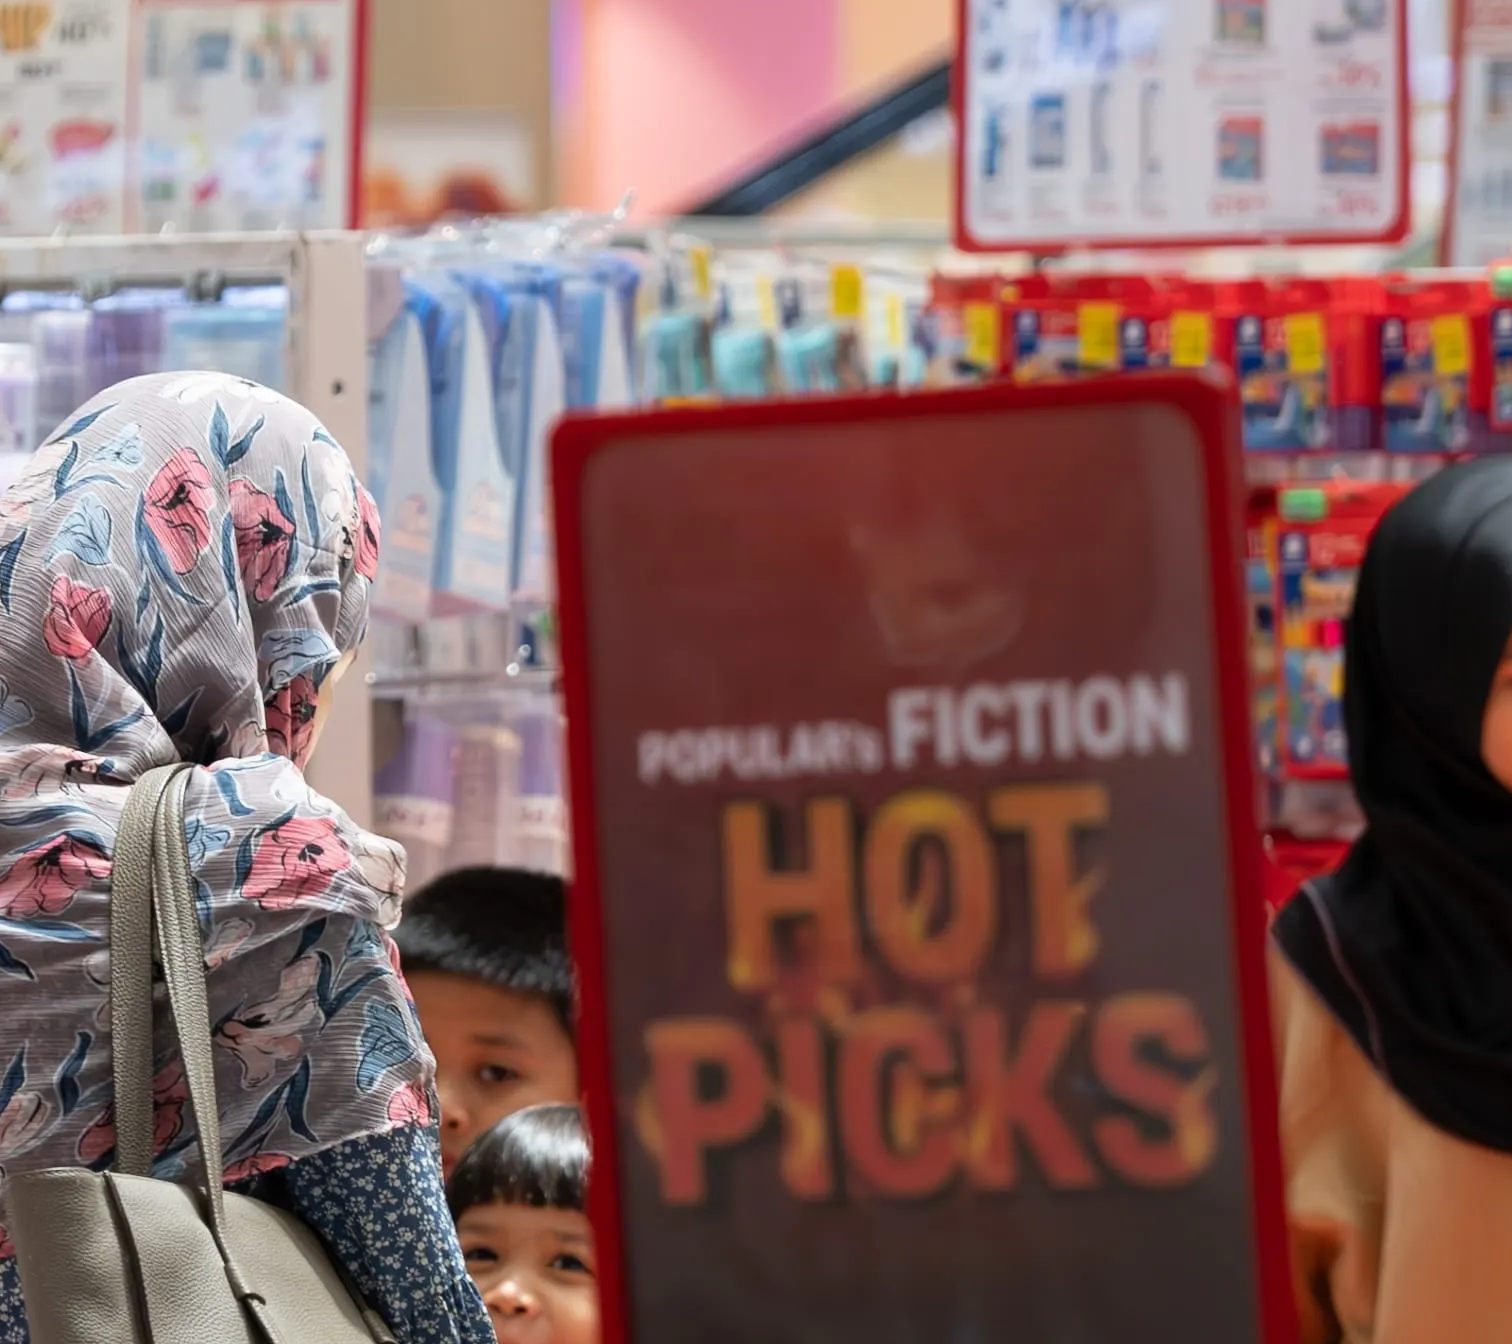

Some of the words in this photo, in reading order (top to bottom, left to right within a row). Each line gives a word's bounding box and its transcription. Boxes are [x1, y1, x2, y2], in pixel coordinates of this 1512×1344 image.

[887, 671, 1189, 764] FICTION
[721, 781, 1111, 993] HOT
[636, 990, 1218, 1206] PICKS
